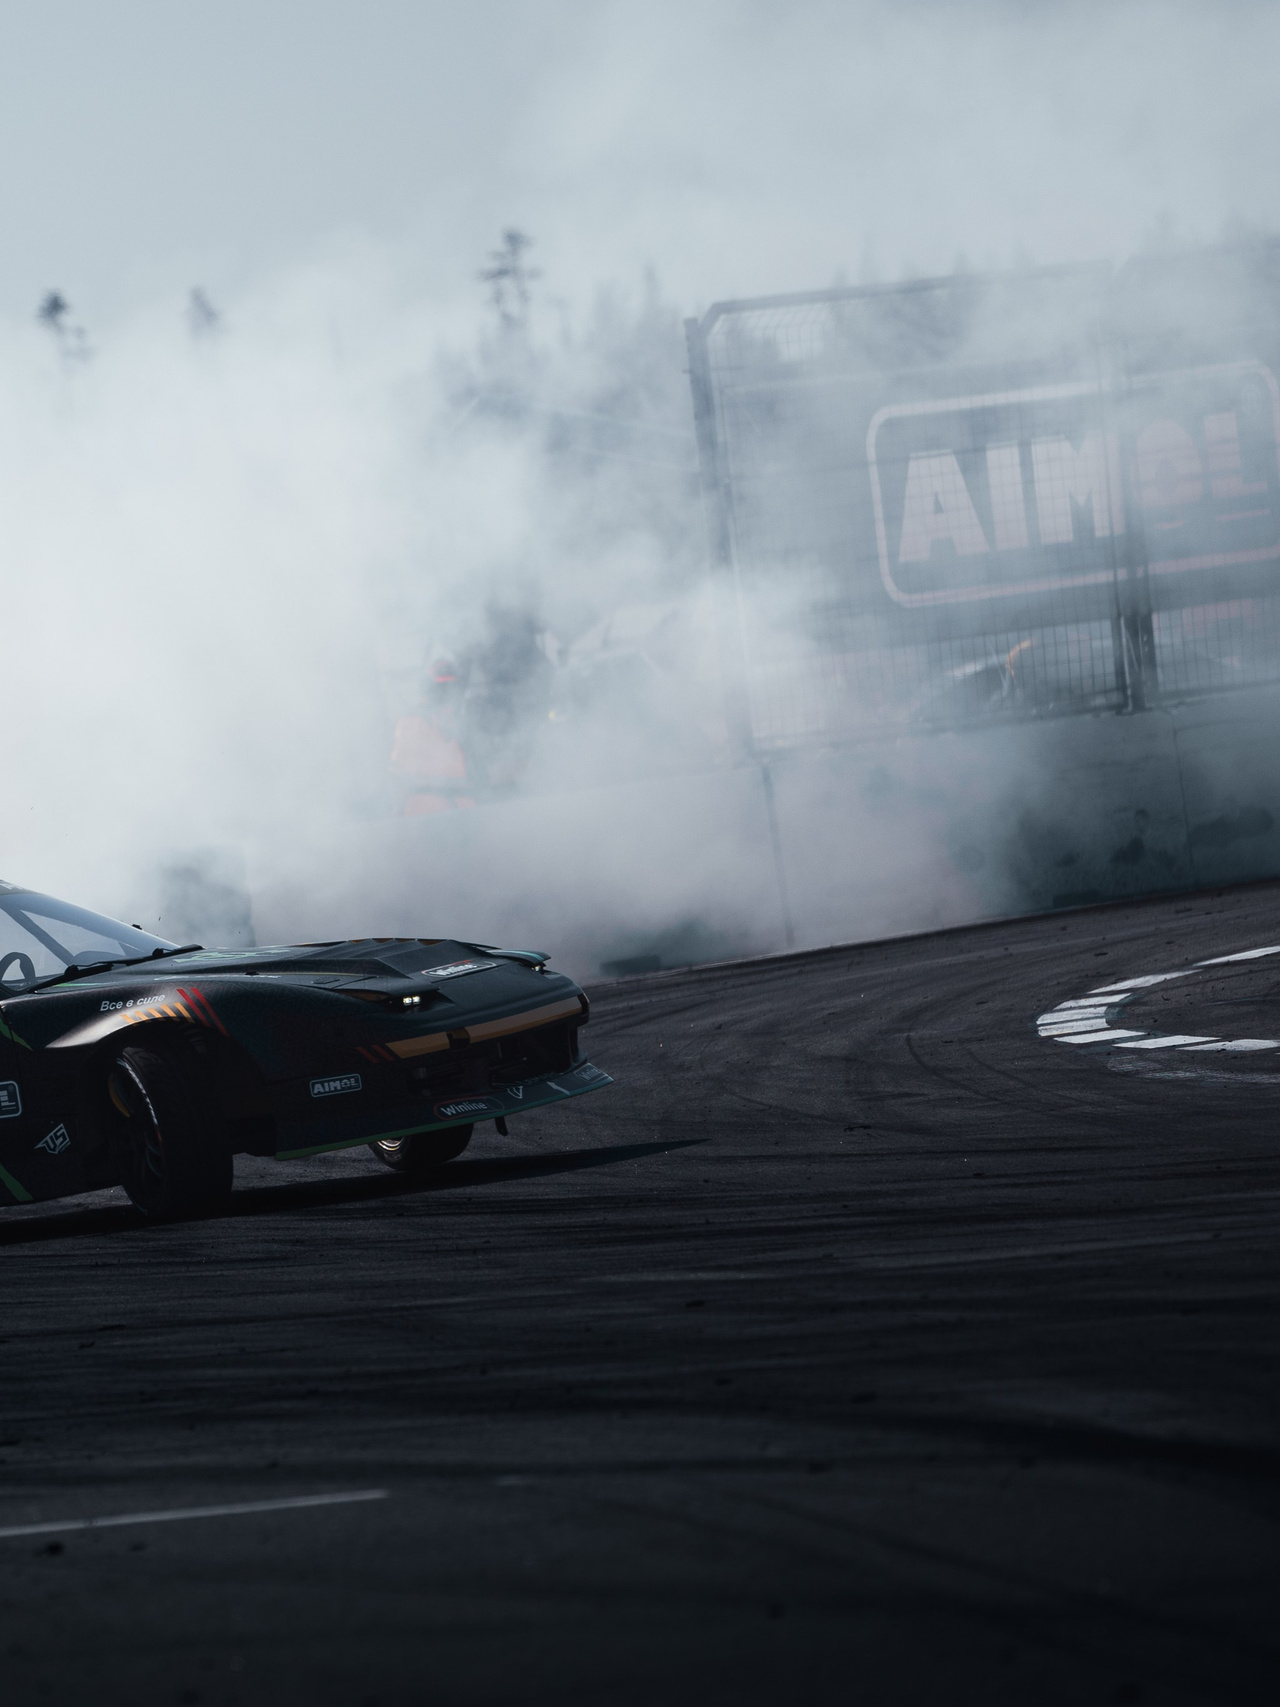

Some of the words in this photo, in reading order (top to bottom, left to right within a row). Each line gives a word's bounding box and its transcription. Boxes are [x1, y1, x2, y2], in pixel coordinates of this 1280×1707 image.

[898, 411, 1269, 563] AIMOL
[99, 999, 122, 1012] Все
[125, 1000, 134, 1009] в
[313, 1077, 360, 1094] AIMOL
[440, 1101, 488, 1116] Winline
